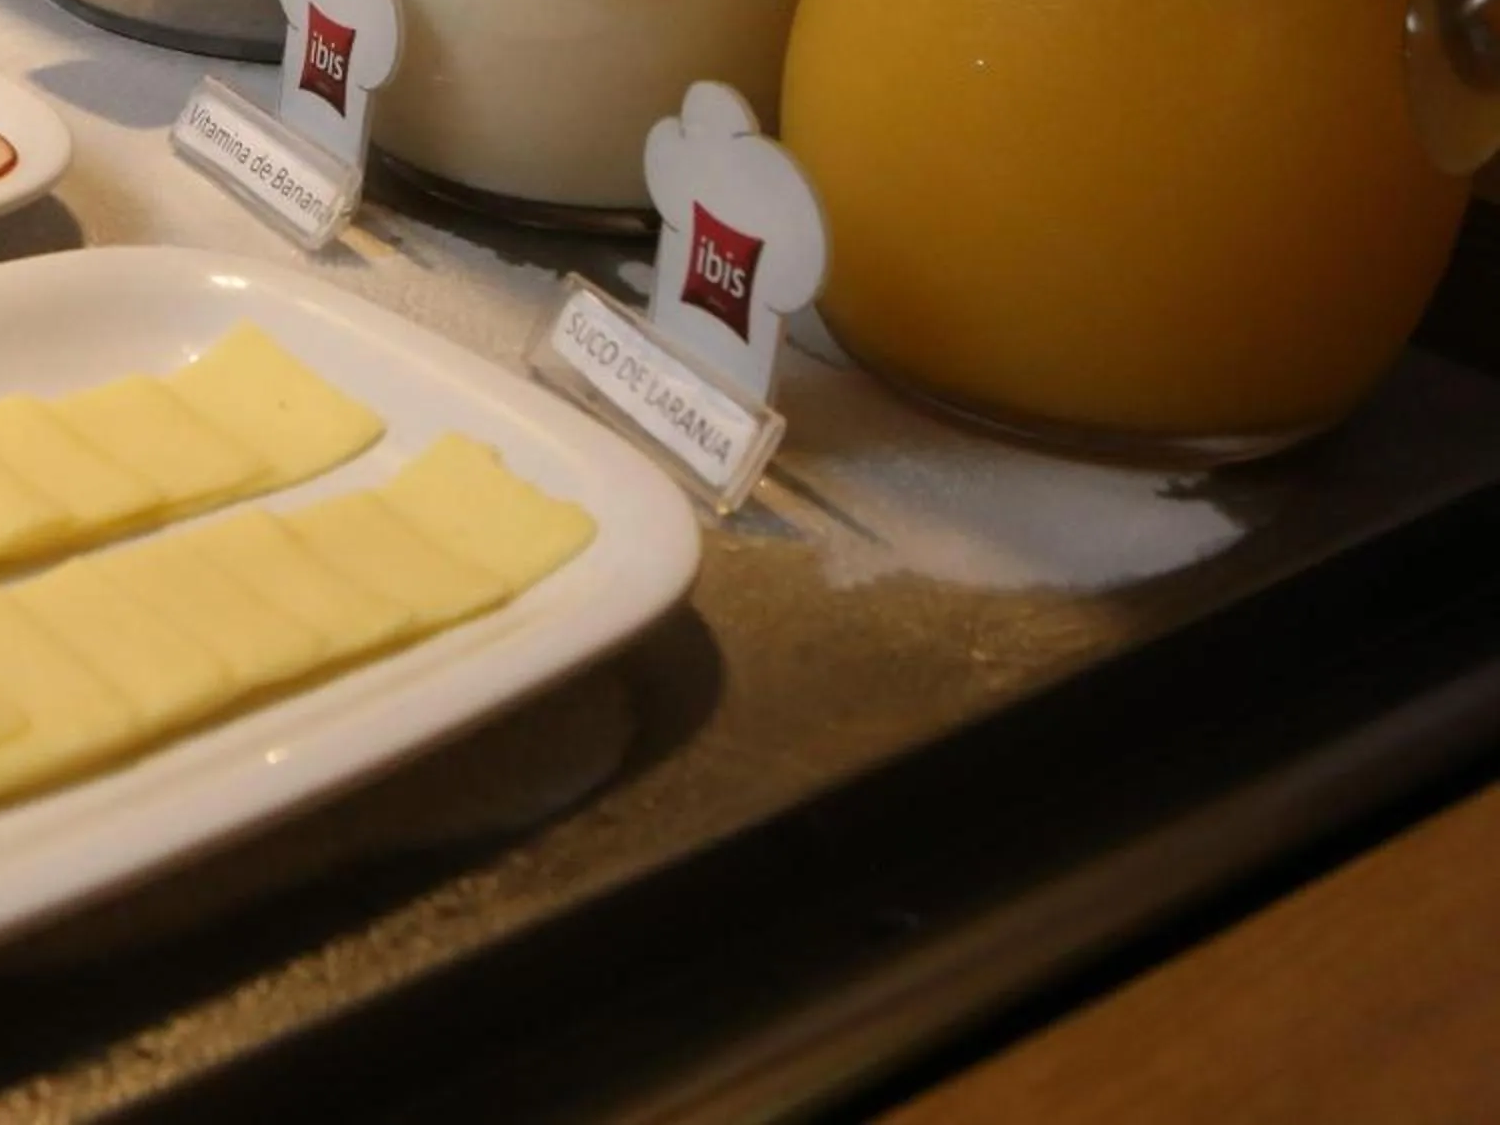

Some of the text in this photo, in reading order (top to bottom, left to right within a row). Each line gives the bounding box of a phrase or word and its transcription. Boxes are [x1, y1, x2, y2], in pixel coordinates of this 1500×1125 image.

[309, 31, 345, 81] ibis
[189, 103, 251, 165] Vitamina
[250, 151, 273, 180] de
[696, 234, 747, 299] ibis
[565, 311, 733, 466] SUCO DE LARANJA
